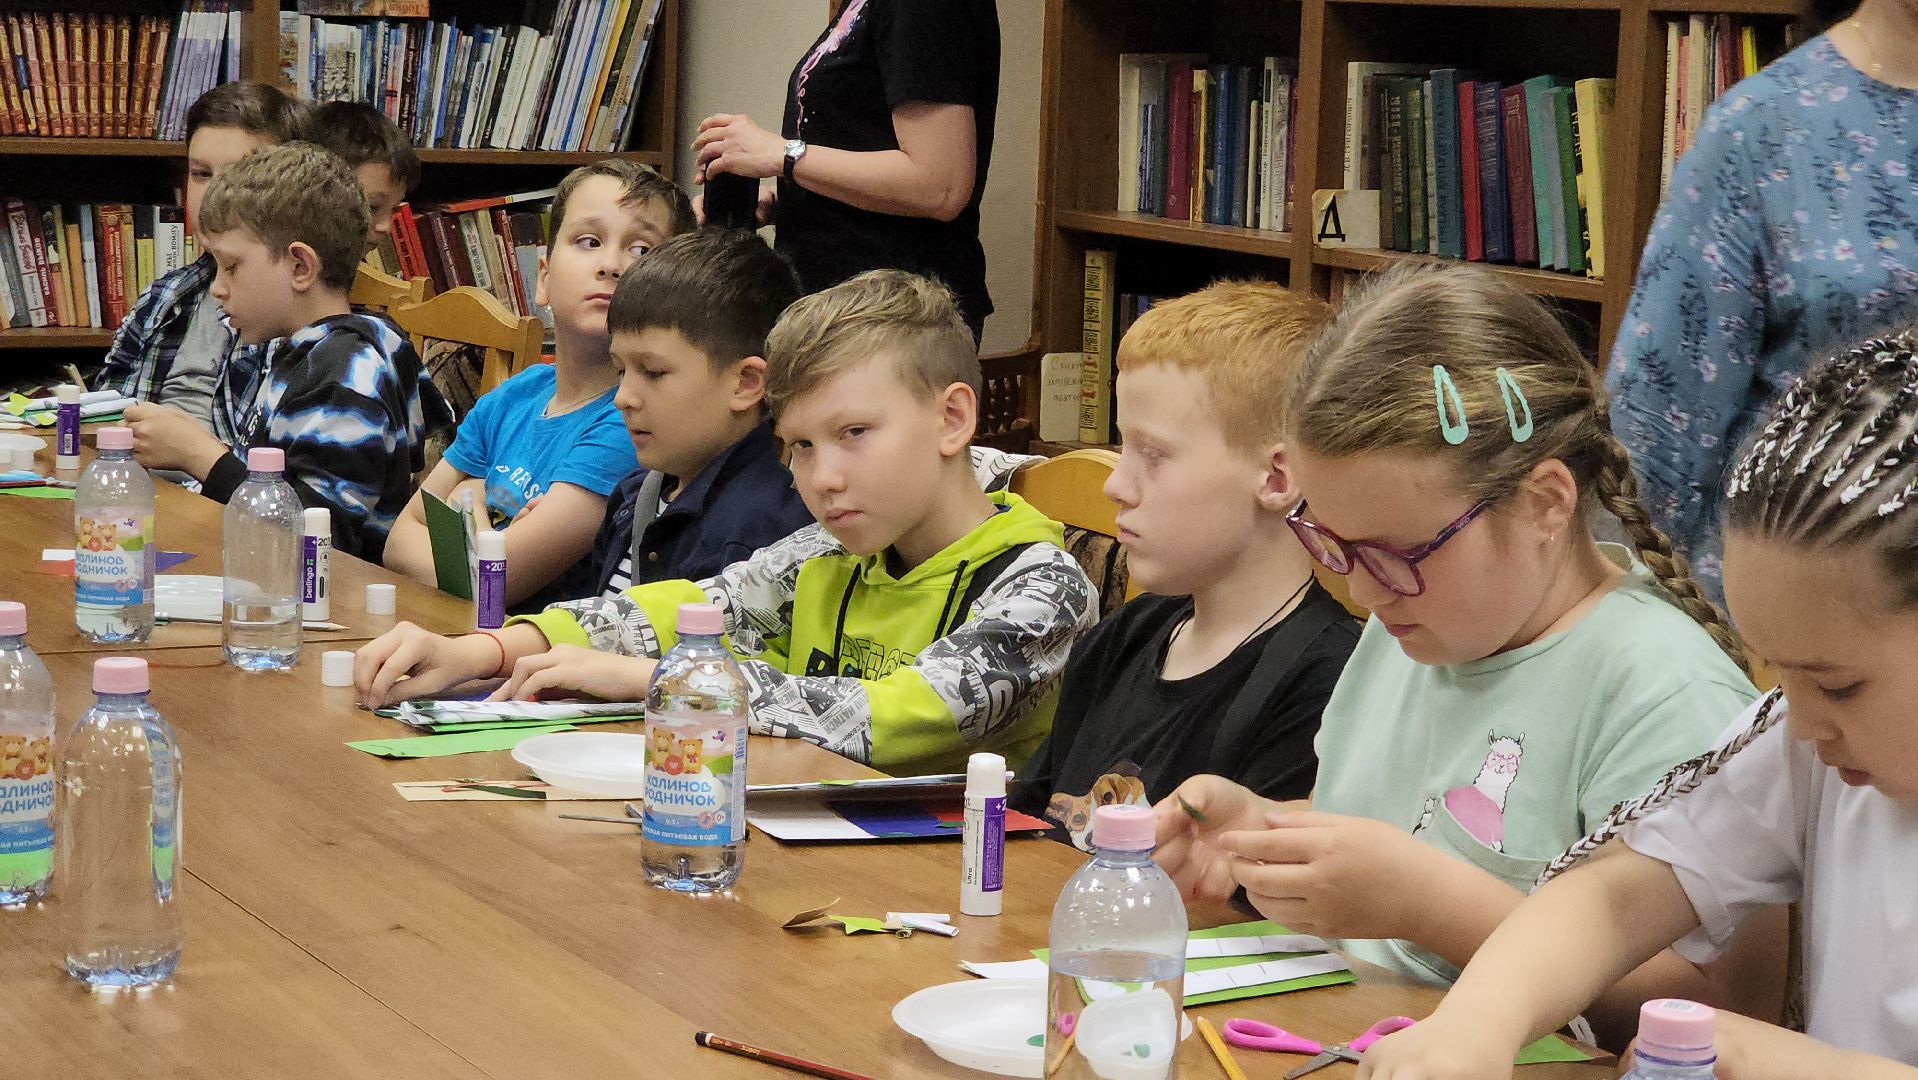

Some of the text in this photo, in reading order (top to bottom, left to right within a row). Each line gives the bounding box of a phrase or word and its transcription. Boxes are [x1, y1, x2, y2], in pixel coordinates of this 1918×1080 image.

[1317, 194, 1346, 243] Д
[34, 237, 50, 295] ВАСИЛЬ БЫКОВ
[76, 562, 128, 575] ОДНИЧОК
[306, 566, 315, 599] berlingo
